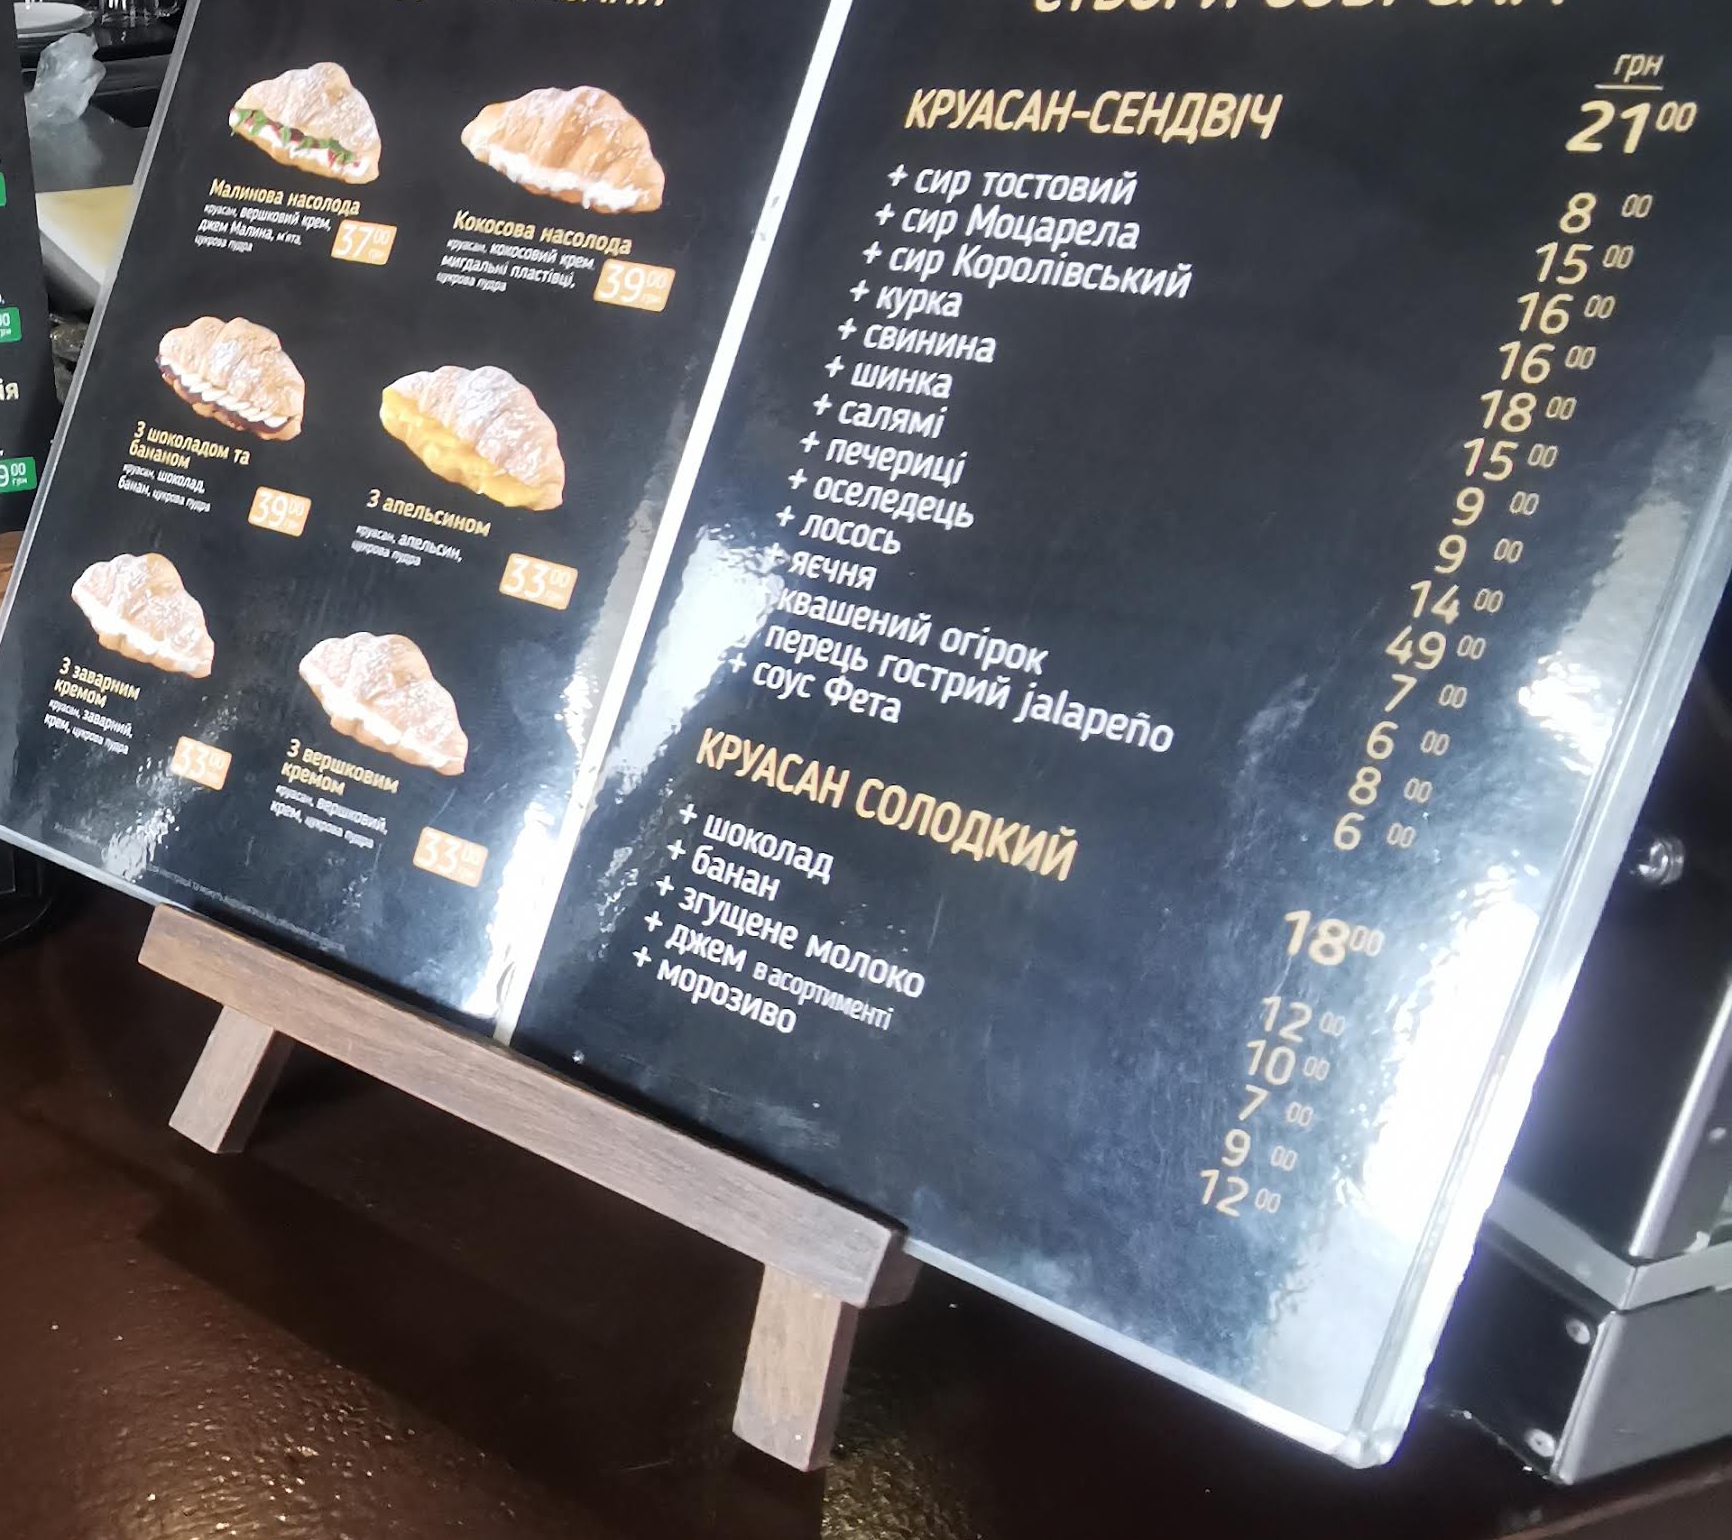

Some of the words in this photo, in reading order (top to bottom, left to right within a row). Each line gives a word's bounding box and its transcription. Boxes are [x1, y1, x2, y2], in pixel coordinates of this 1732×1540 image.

[1612, 51, 1666, 83] грн
[902, 86, 1286, 146] КРУАСАН-СЕНДВІЧ
[209, 177, 285, 207] Малинова
[287, 190, 362, 218] насолода
[452, 208, 536, 241] Кокосова
[538, 225, 633, 257] насолода
[913, 166, 973, 200] сир
[981, 168, 1139, 208] тостовий
[1558, 191, 1598, 235] 8
[900, 205, 960, 243] сир
[965, 202, 1142, 252] Моцарела
[1534, 241, 1595, 286] 15
[887, 244, 947, 282] сир
[950, 242, 1195, 300] Королівський
[1516, 290, 1575, 336] 16
[875, 284, 965, 322] курка
[1497, 340, 1556, 385] 16
[862, 321, 998, 365] свинина
[1478, 388, 1538, 434] 18
[128, 437, 193, 471] бананом
[147, 427, 231, 463] шоколадом
[231, 447, 252, 467] та
[836, 399, 950, 441] салямі
[1450, 486, 1487, 528] 9
[849, 360, 955, 401] шинка
[1462, 437, 1521, 483] 15
[382, 494, 493, 539] апельсином
[824, 435, 970, 490] печериці
[1433, 533, 1469, 575] 9
[787, 548, 880, 593] яєчня
[799, 512, 903, 558] лосось
[1384, 624, 1449, 671] 49
[812, 473, 976, 532] оселедець
[1409, 579, 1461, 626] 14
[776, 587, 933, 648] квашений
[938, 625, 1051, 677] огірок
[52, 676, 108, 710] кремом
[71, 662, 142, 702] заварним
[751, 660, 817, 702] соус
[823, 674, 903, 725] Фета
[763, 622, 871, 676] перець
[876, 650, 1013, 712] гострий
[1011, 680, 1176, 755] jalapeño
[279, 760, 347, 798] кремом
[301, 746, 401, 795] вершковим
[695, 725, 852, 811] КРУАСАН
[853, 776, 1080, 883] СОЛОДКИЙ
[664, 922, 749, 974] джем
[676, 884, 800, 952] згущене
[803, 931, 927, 1001] молоко
[690, 844, 782, 902] банан
[1246, 1038, 1297, 1087] 10
[701, 812, 835, 887] шоколад
[1260, 995, 1314, 1044] 12
[655, 958, 798, 1036] морозиво
[1198, 1168, 1251, 1219] 12
